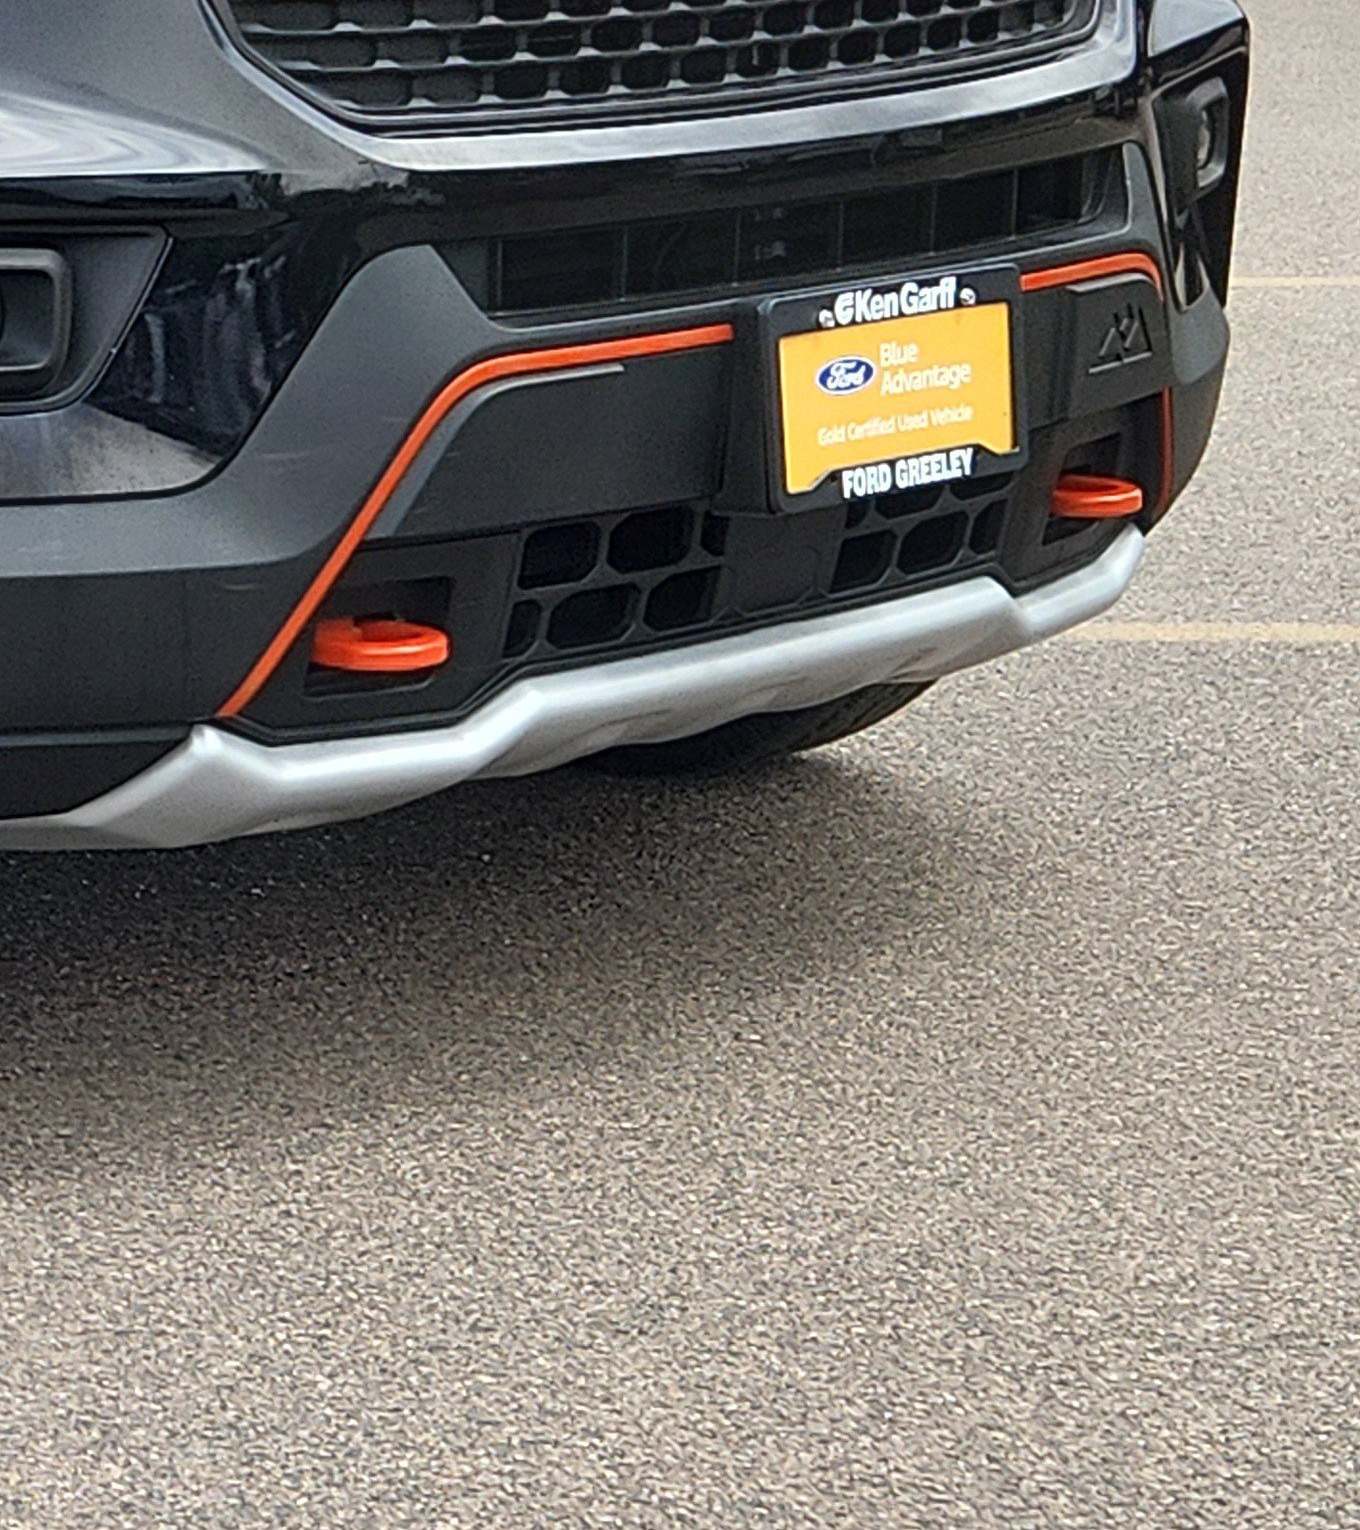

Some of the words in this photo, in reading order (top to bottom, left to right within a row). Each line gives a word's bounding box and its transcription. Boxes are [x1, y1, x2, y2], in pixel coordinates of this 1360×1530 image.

[879, 342, 919, 367] Blue
[823, 358, 871, 391] Ford
[881, 362, 972, 397] Advantage
[817, 425, 846, 446] Gold
[847, 415, 896, 441] Certified
[897, 410, 929, 433] Used
[930, 403, 975, 427] Vehicle
[841, 463, 893, 499] FORD
[895, 447, 974, 490] GREELEY
